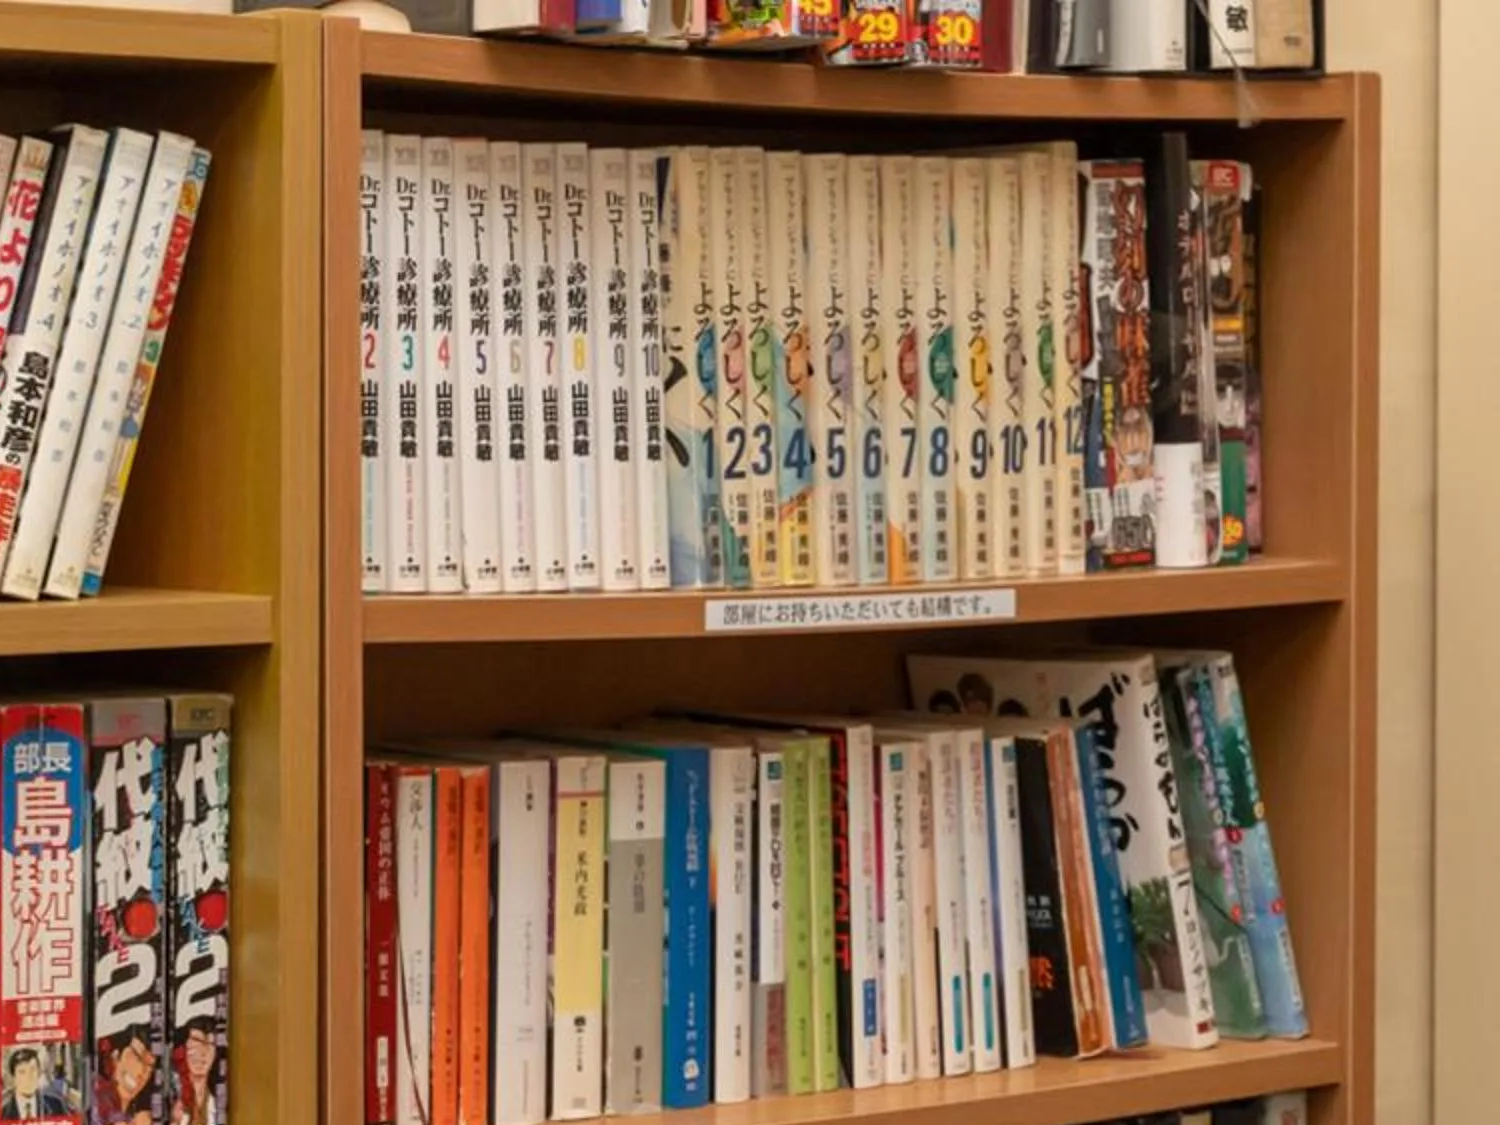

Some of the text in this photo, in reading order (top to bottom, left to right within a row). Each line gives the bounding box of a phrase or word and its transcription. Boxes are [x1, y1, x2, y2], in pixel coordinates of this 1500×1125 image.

[859, 14, 898, 42] 29
[936, 16, 973, 43] 30
[402, 334, 415, 371] 3
[437, 333, 451, 369] 4
[475, 340, 488, 376] 5
[509, 340, 522, 374] 6
[573, 337, 587, 371] 8
[399, 380, 419, 459] 山田貴敏
[435, 380, 454, 459] 山田貴敏
[474, 384, 493, 461] 山田貴敏
[506, 382, 526, 460] 山田貴敏
[572, 380, 590, 459] 山田貴敏
[1036, 416, 1056, 466] 11
[723, 426, 747, 480] 2
[826, 427, 846, 479] 5
[863, 427, 882, 478] 6
[929, 426, 949, 478] 8
[970, 427, 987, 480] 9
[1000, 425, 1025, 475] 10
[722, 594, 992, 626] 部屋にお持ちいただいても結構です。
[13, 741, 72, 775] 部長
[9, 777, 77, 997] 島耕作
[94, 940, 156, 1041] 2
